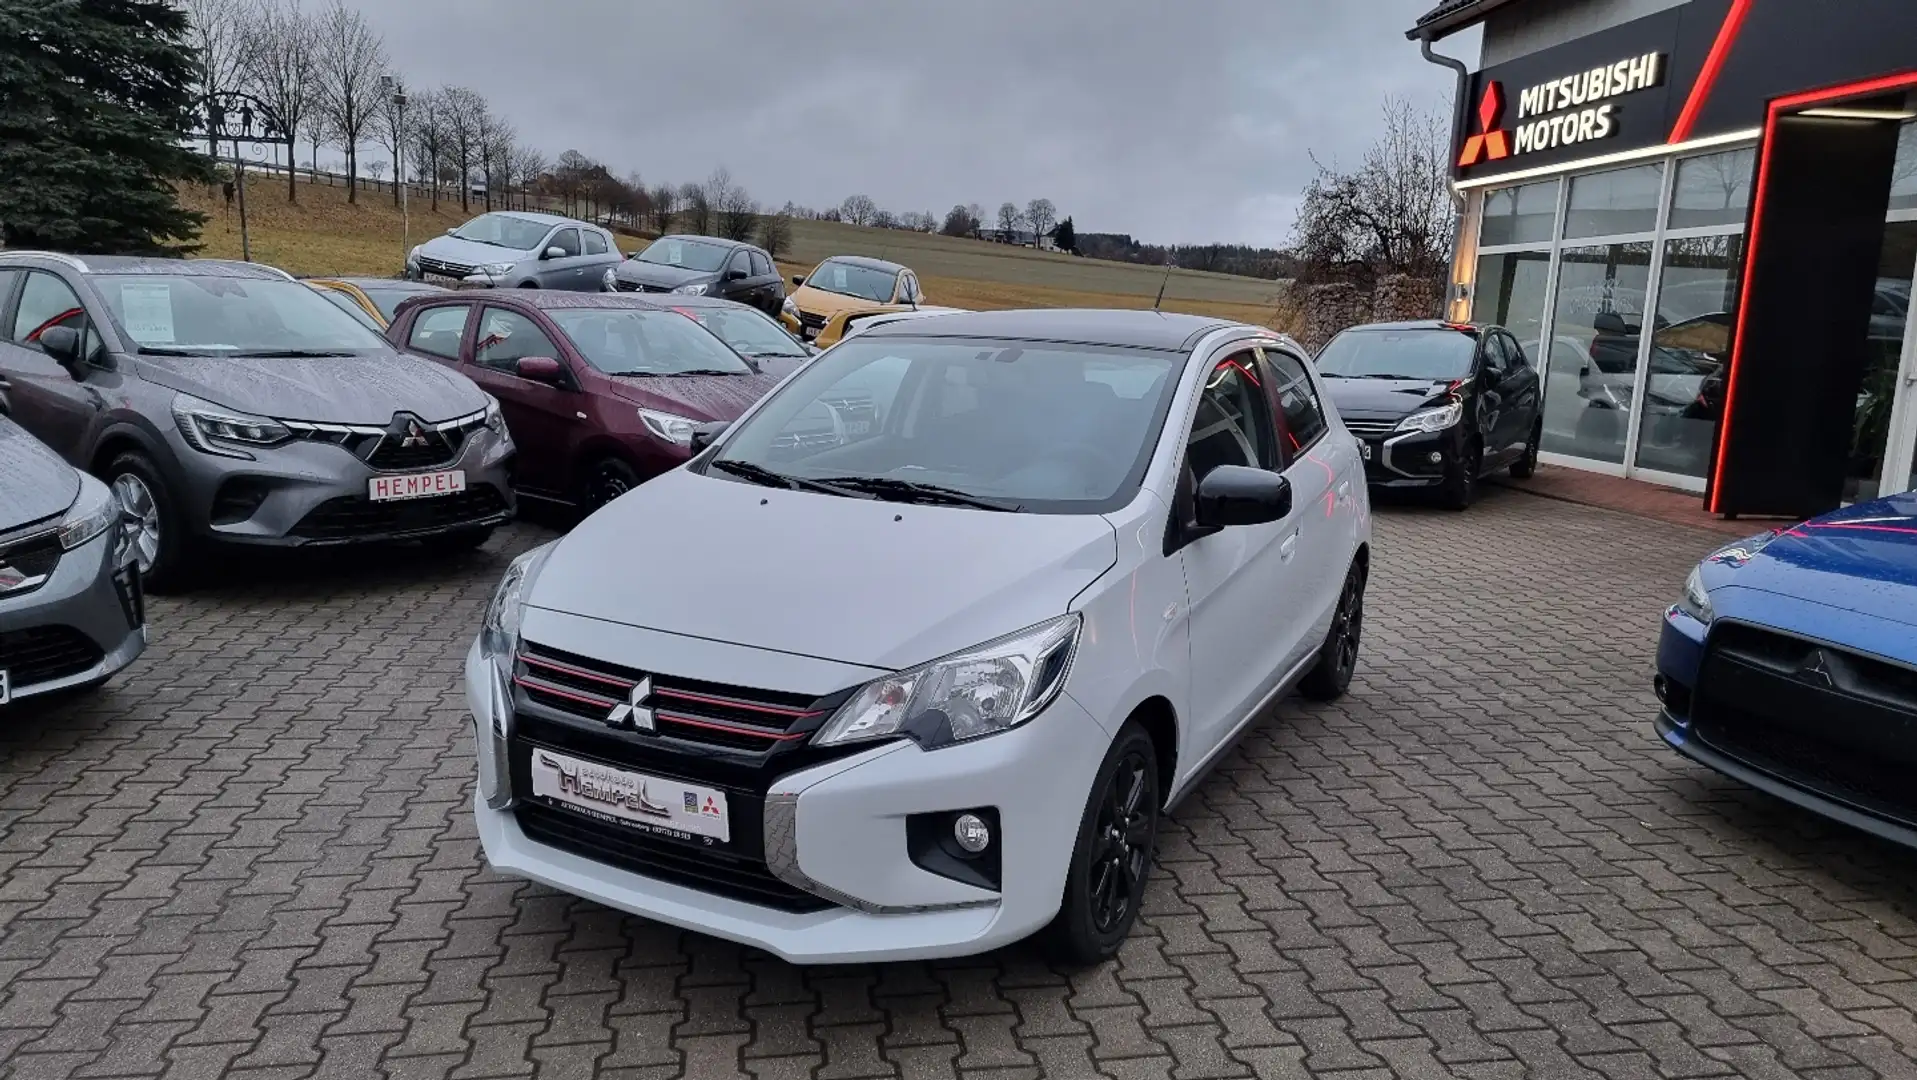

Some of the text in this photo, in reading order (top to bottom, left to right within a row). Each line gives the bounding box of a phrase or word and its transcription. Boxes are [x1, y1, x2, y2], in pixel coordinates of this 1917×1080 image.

[1518, 51, 1657, 118] MITSUBISHI
[1514, 104, 1612, 155] MOTORS
[377, 474, 459, 496] HEMPEL
